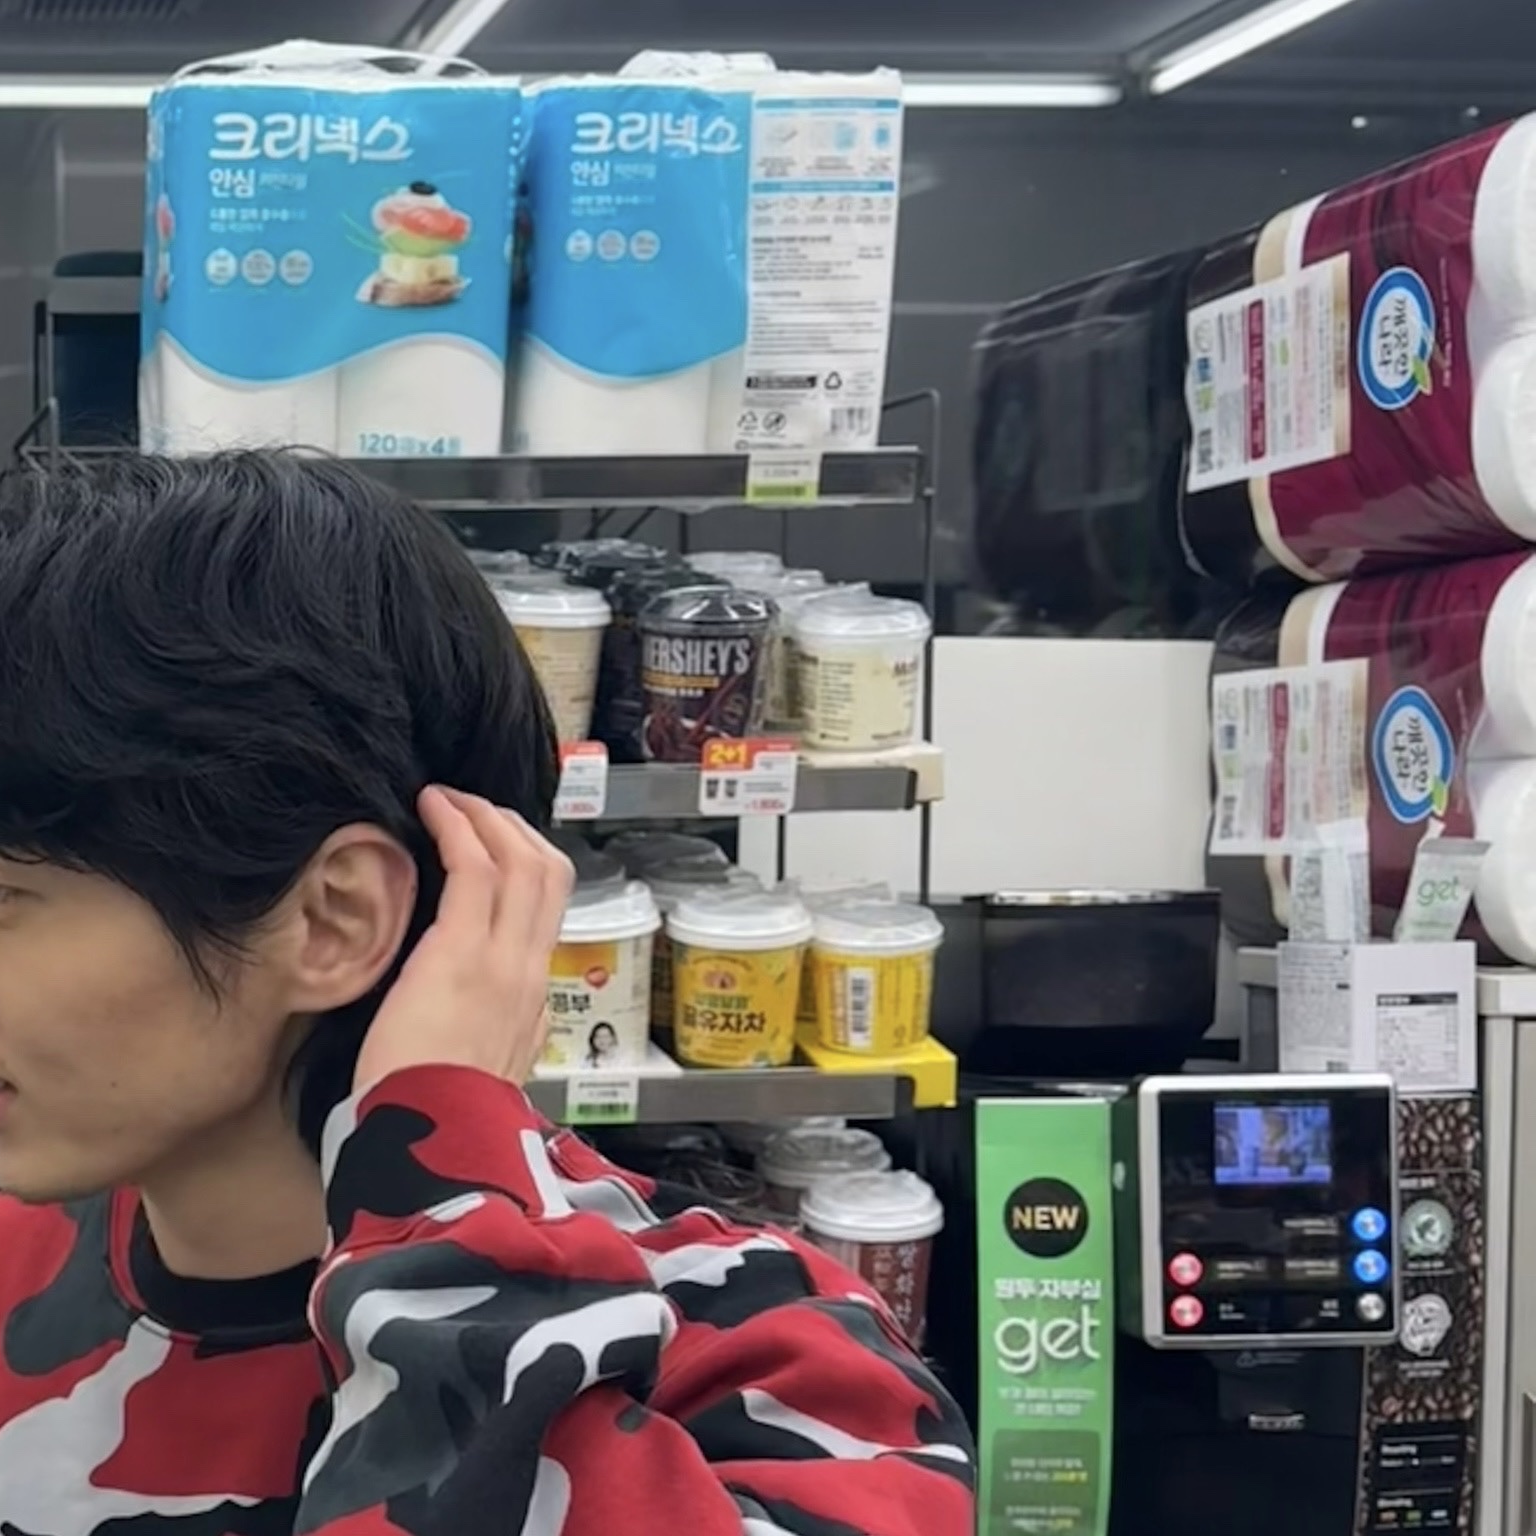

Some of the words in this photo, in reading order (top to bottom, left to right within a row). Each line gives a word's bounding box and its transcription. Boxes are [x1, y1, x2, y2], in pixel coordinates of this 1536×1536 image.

[208, 111, 413, 164] 크리넥스
[570, 111, 743, 157] 크리넥스
[208, 167, 256, 199] 안심
[570, 159, 611, 187] 안심
[709, 742, 748, 765] 2+1
[1417, 876, 1461, 907] get
[1012, 1205, 1080, 1231] NEW
[994, 1304, 1101, 1374] get
